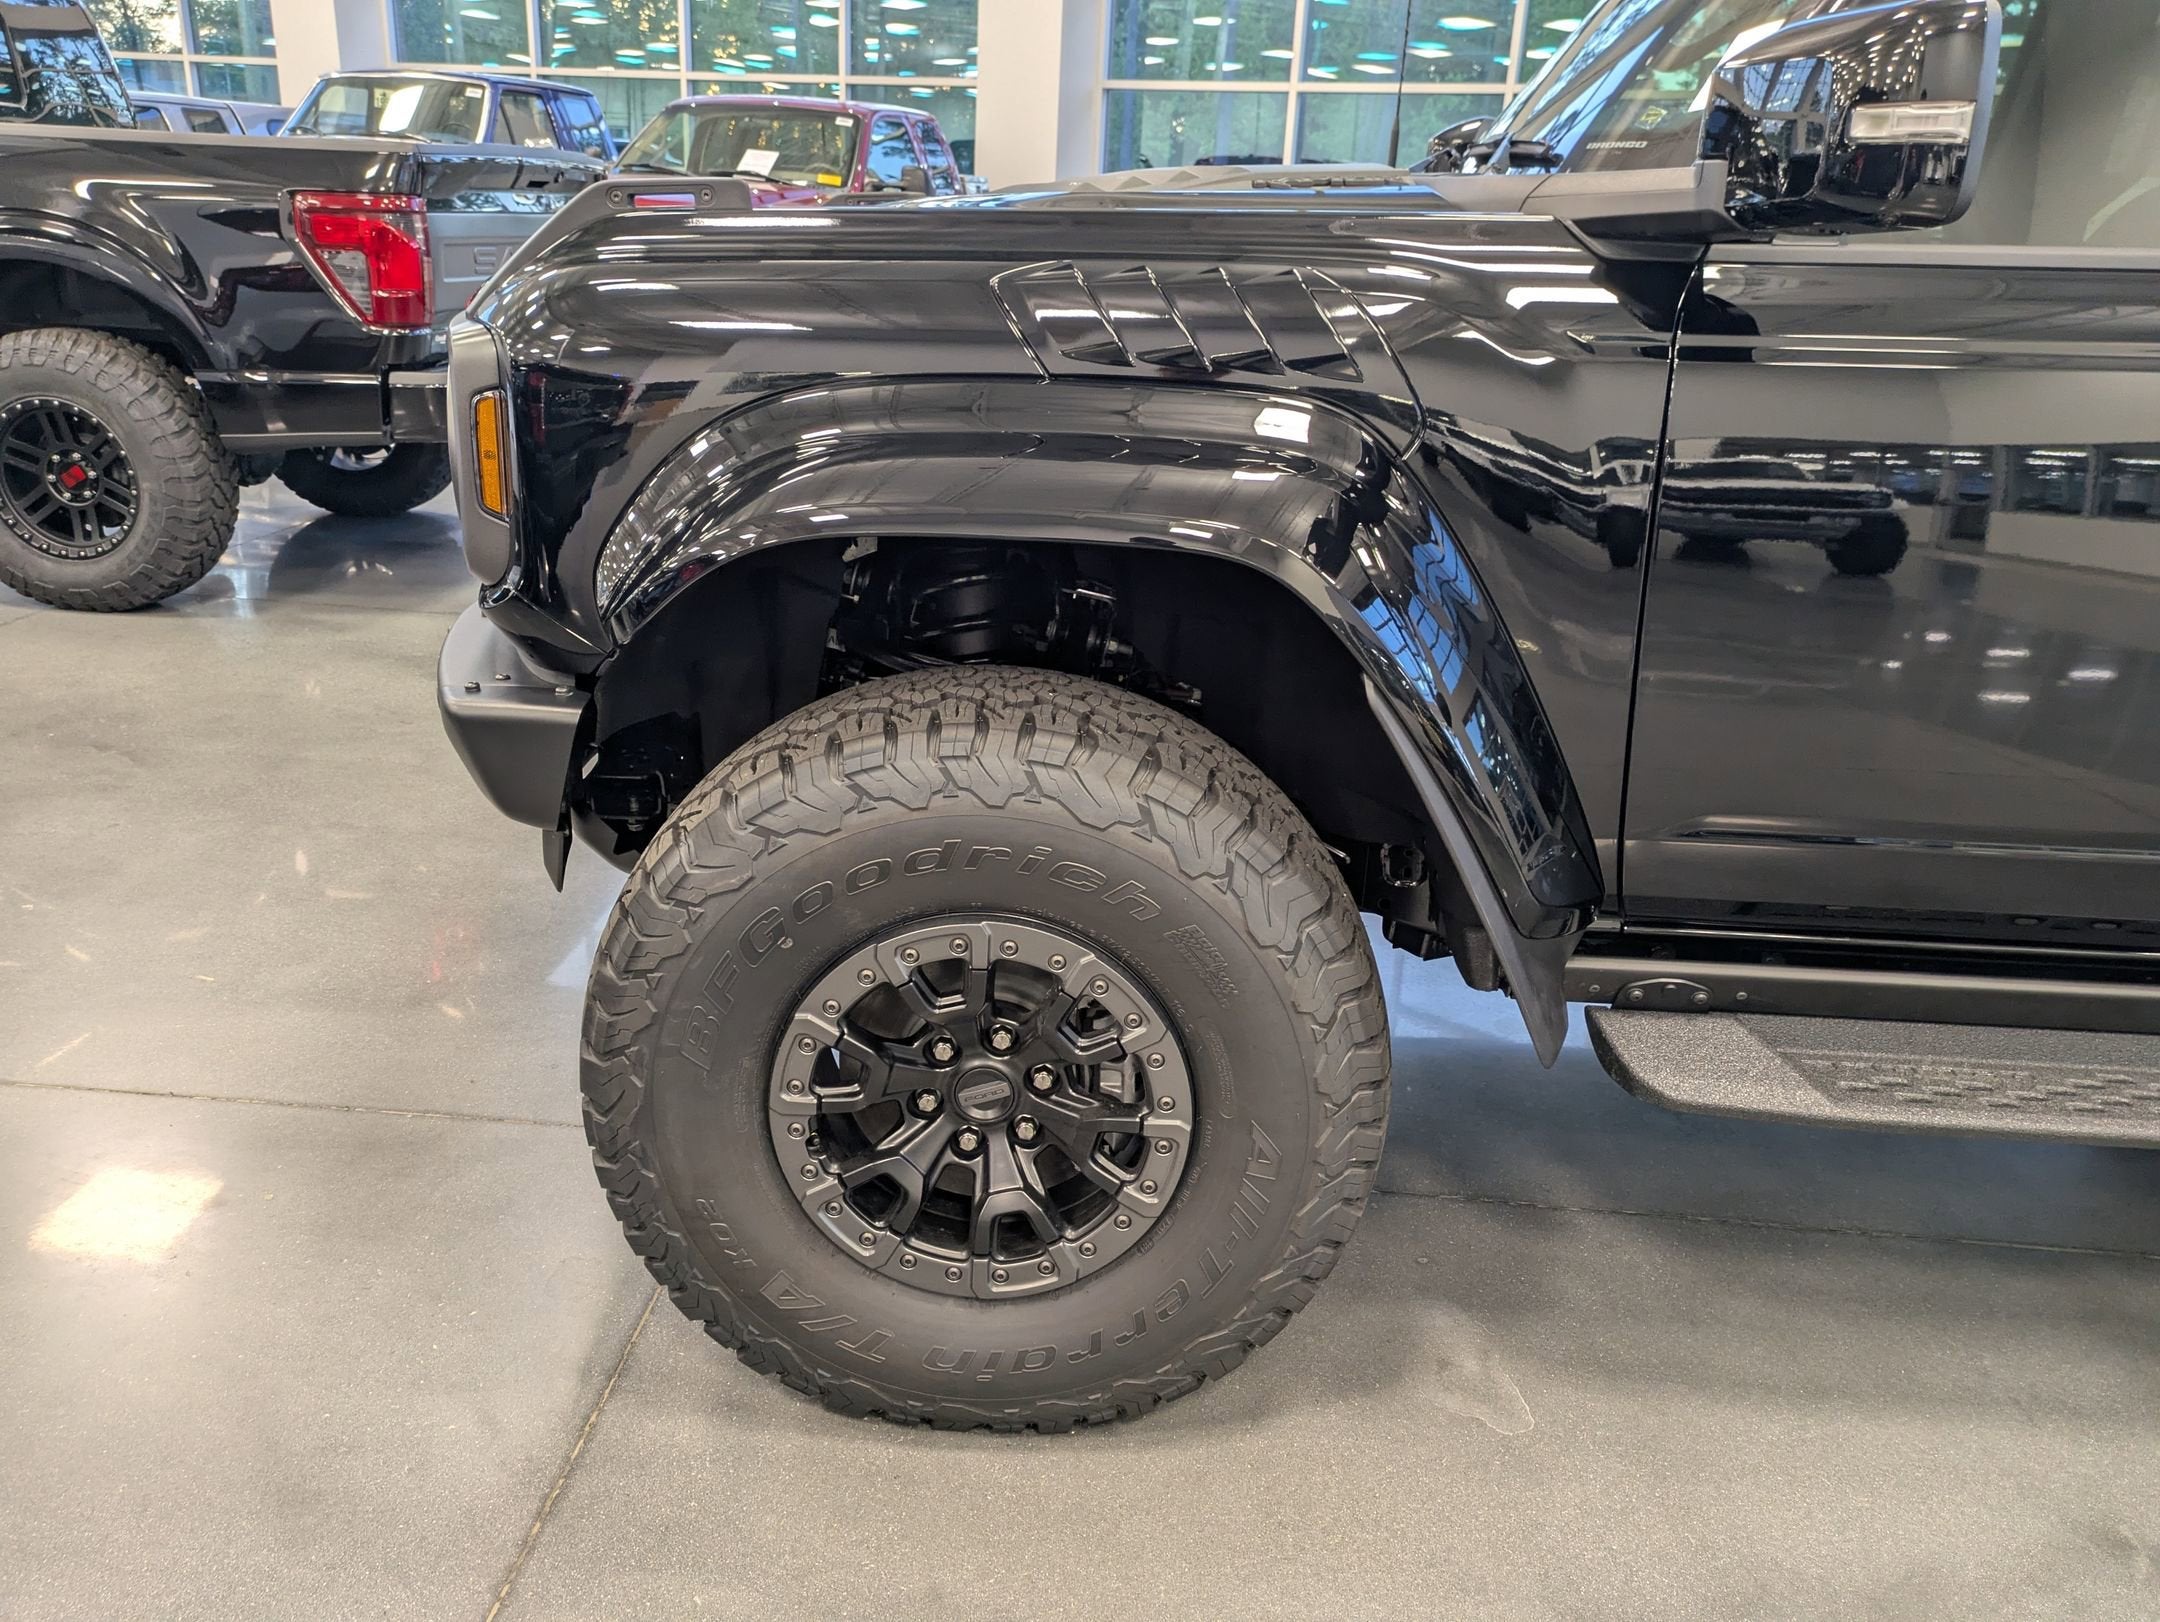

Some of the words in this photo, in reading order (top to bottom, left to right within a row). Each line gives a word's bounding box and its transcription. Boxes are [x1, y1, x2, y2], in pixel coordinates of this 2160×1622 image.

[678, 839, 1164, 1071] BFGoodrich
[964, 1088, 1005, 1102] FORD
[760, 1270, 895, 1364] T/A
[922, 1119, 1283, 1382] All-Terrain
